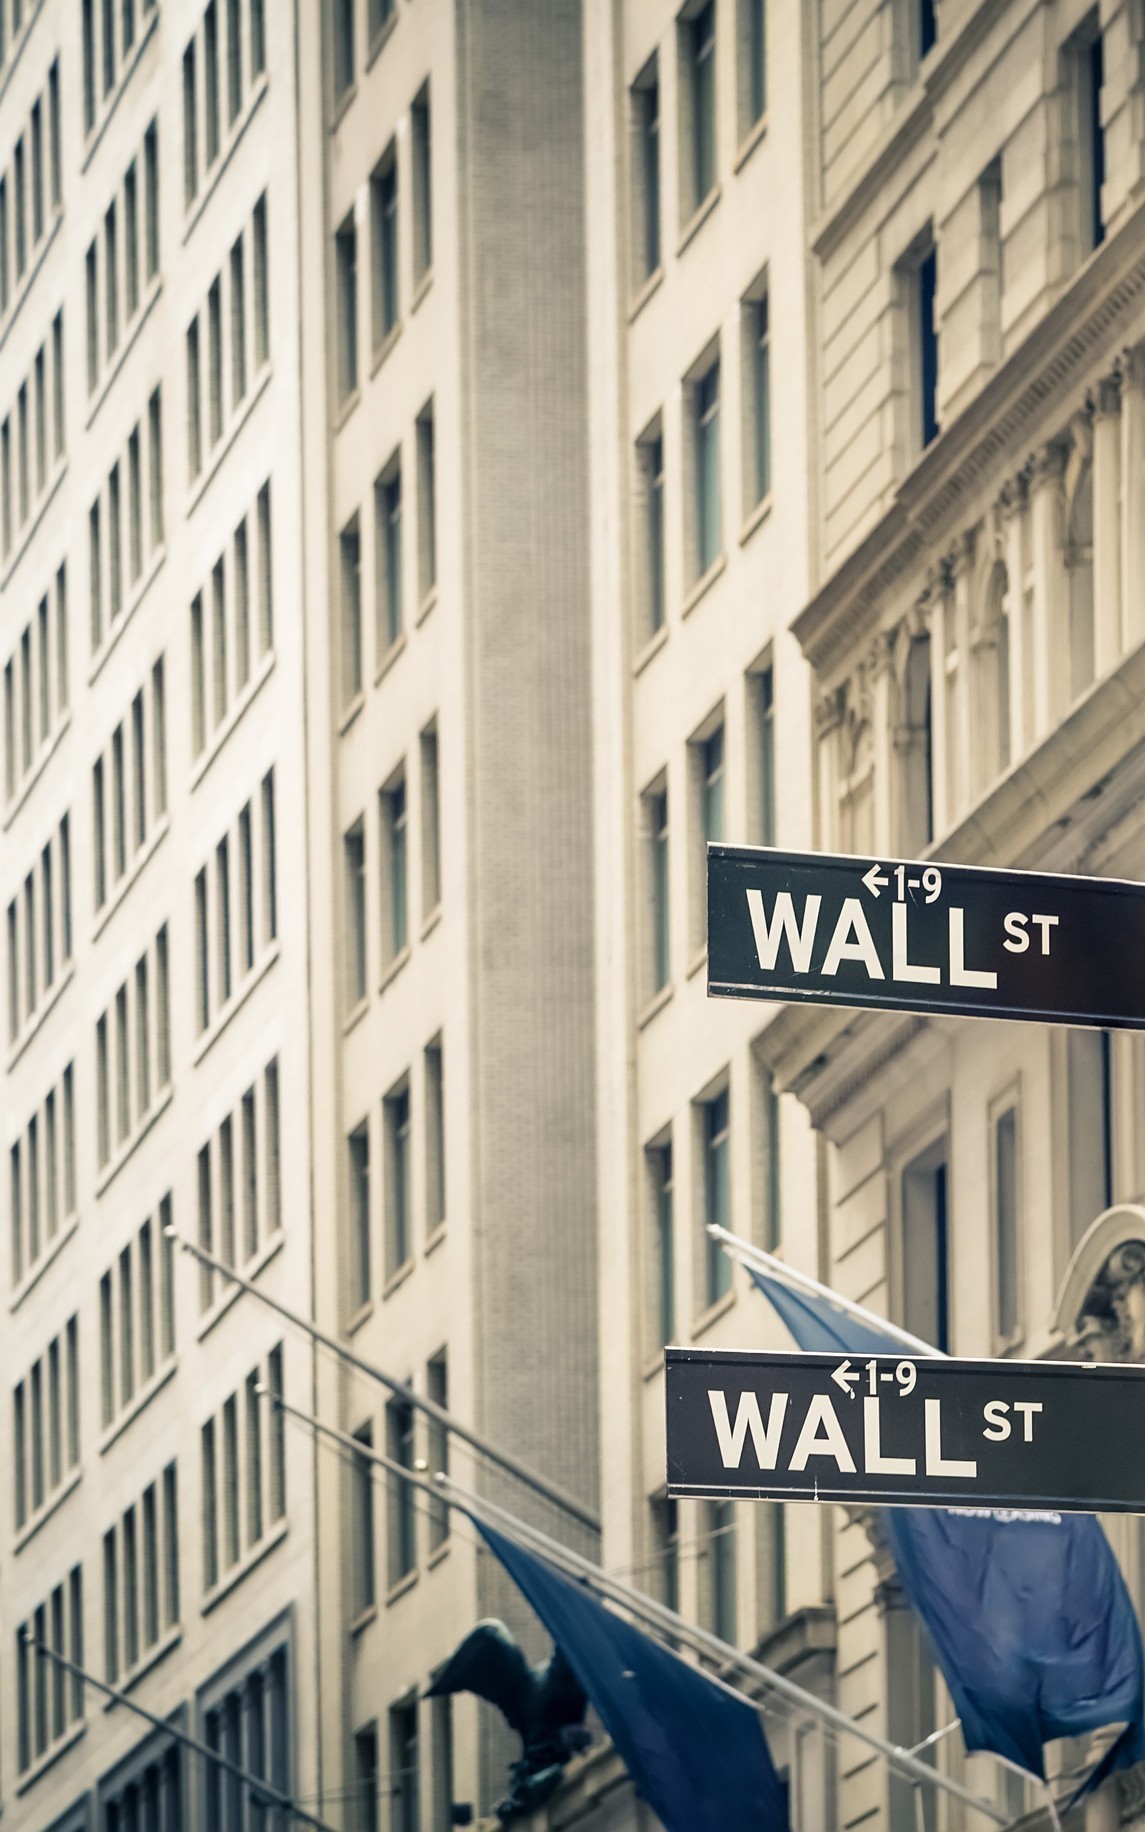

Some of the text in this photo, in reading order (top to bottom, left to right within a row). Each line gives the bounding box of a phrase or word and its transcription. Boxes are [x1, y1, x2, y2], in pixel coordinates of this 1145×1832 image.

[893, 864, 942, 904] 1-9
[745, 888, 1059, 990] WALL ST
[866, 1359, 917, 1397] 1-9
[707, 1389, 1043, 1478] WALL ST
